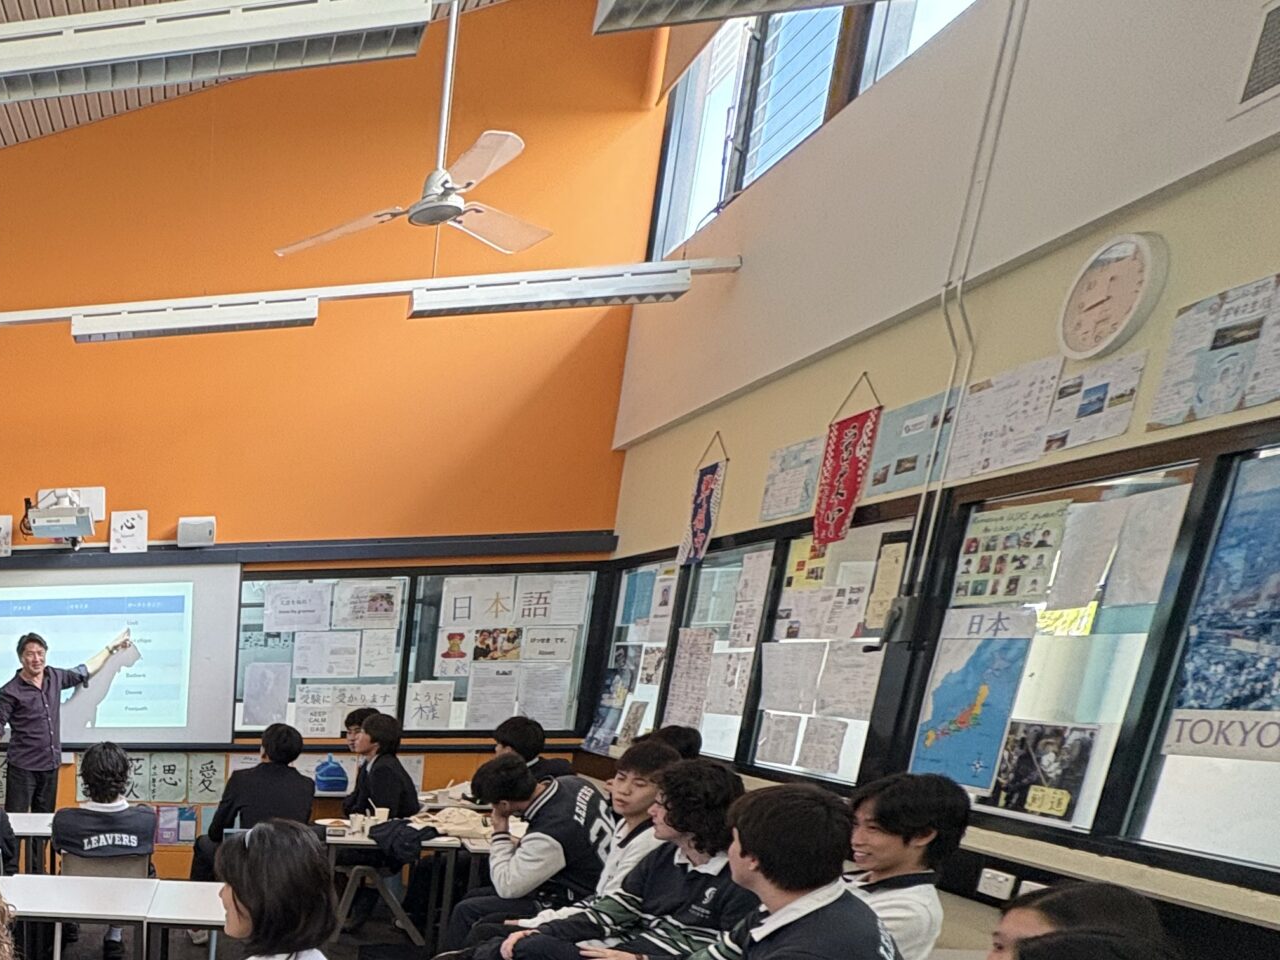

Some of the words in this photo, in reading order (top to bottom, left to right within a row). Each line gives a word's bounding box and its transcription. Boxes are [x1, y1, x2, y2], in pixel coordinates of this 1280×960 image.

[966, 611, 1011, 637] 日本
[1174, 718, 1280, 748] TOKYO
[198, 759, 218, 794] 愛
[572, 784, 596, 827] LEAVERS
[82, 832, 139, 851] LEAVERS
